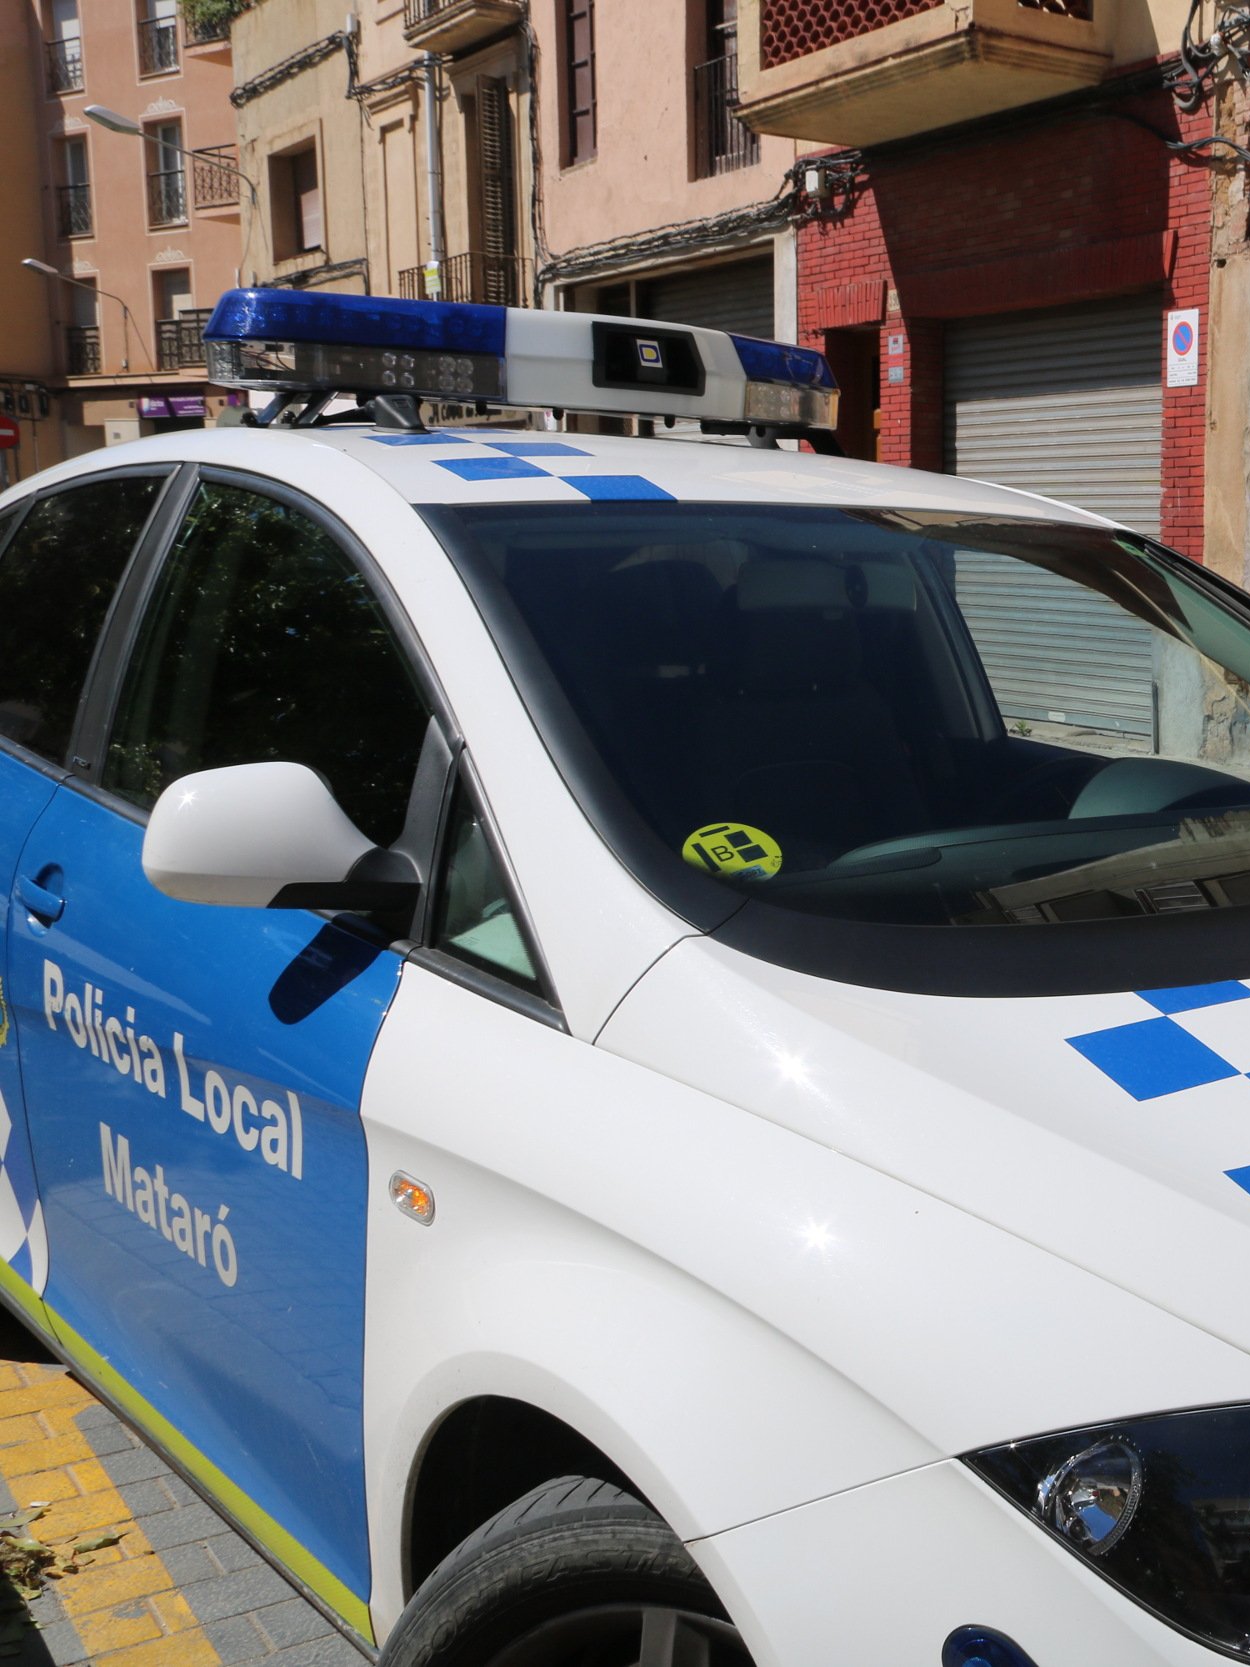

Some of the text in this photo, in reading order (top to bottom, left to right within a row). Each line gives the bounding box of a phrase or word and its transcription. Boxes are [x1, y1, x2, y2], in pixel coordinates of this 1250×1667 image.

[711, 845, 735, 862] B
[43, 959, 302, 1180] Policia Local
[100, 1121, 238, 1288] Mataró
